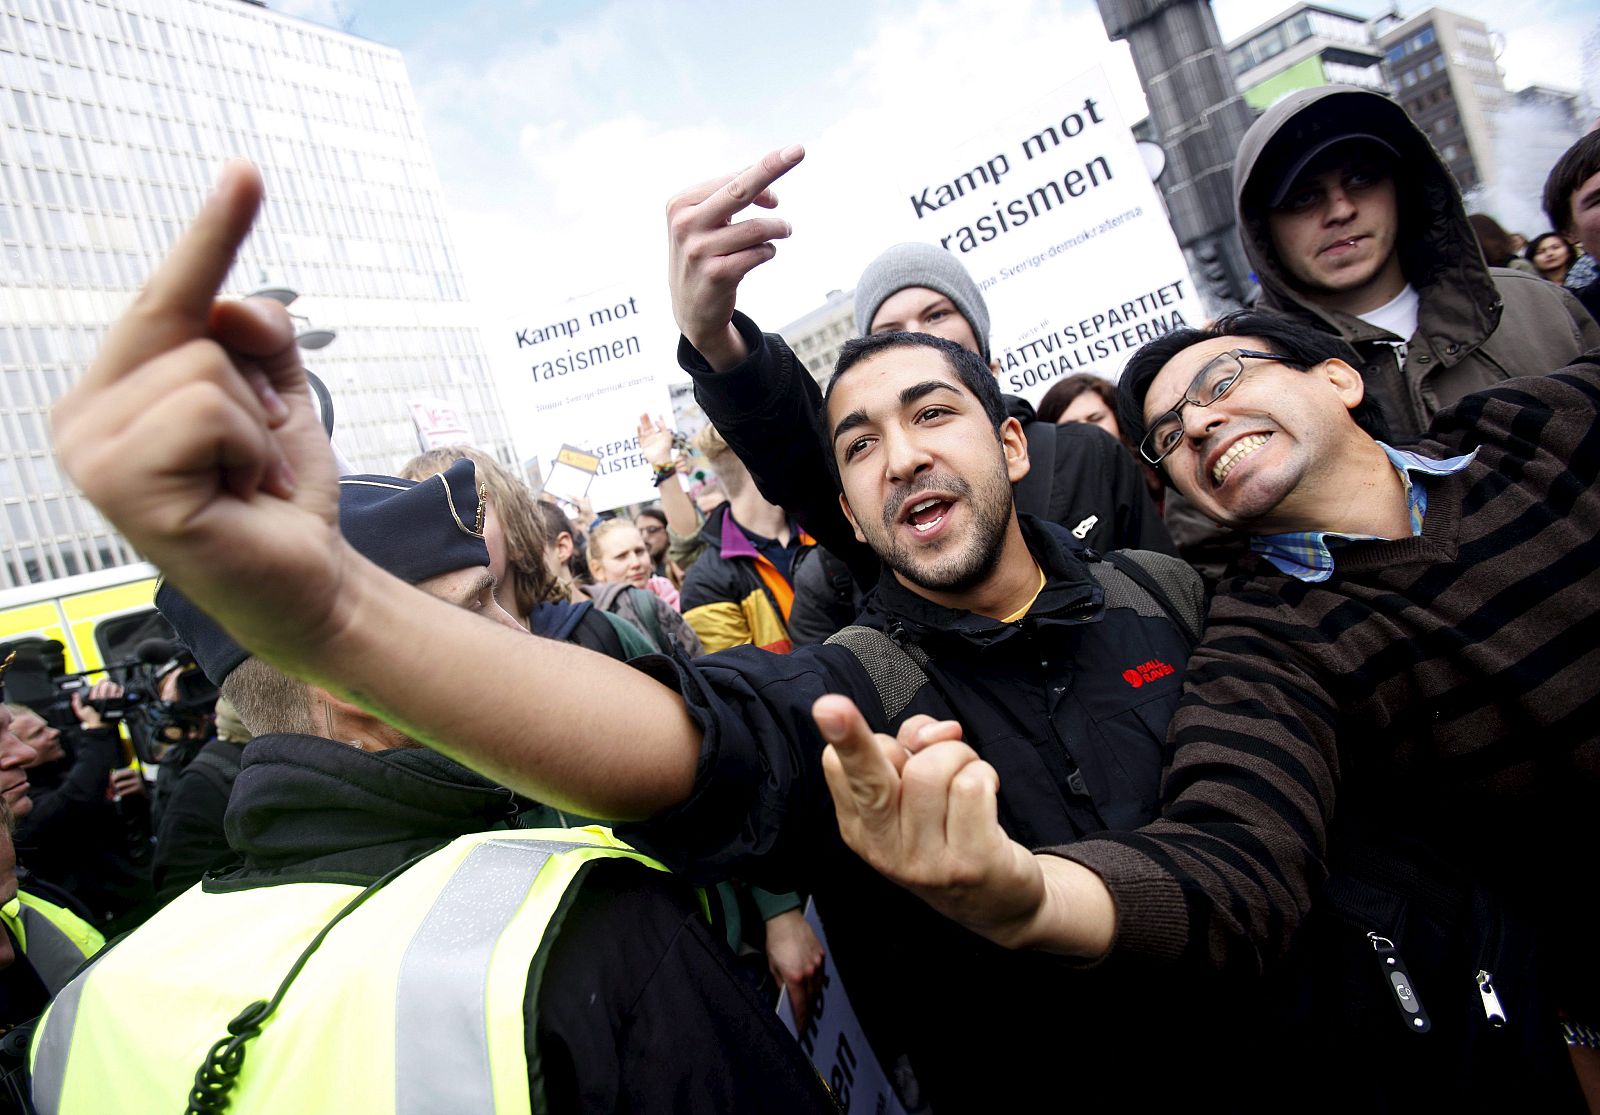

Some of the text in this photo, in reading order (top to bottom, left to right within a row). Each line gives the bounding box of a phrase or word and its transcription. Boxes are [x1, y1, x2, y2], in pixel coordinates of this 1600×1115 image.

[910, 97, 1104, 219] Kamp mot
[940, 155, 1113, 253] rasismen
[515, 296, 639, 349] Kamp mot
[531, 335, 641, 383] rasismen
